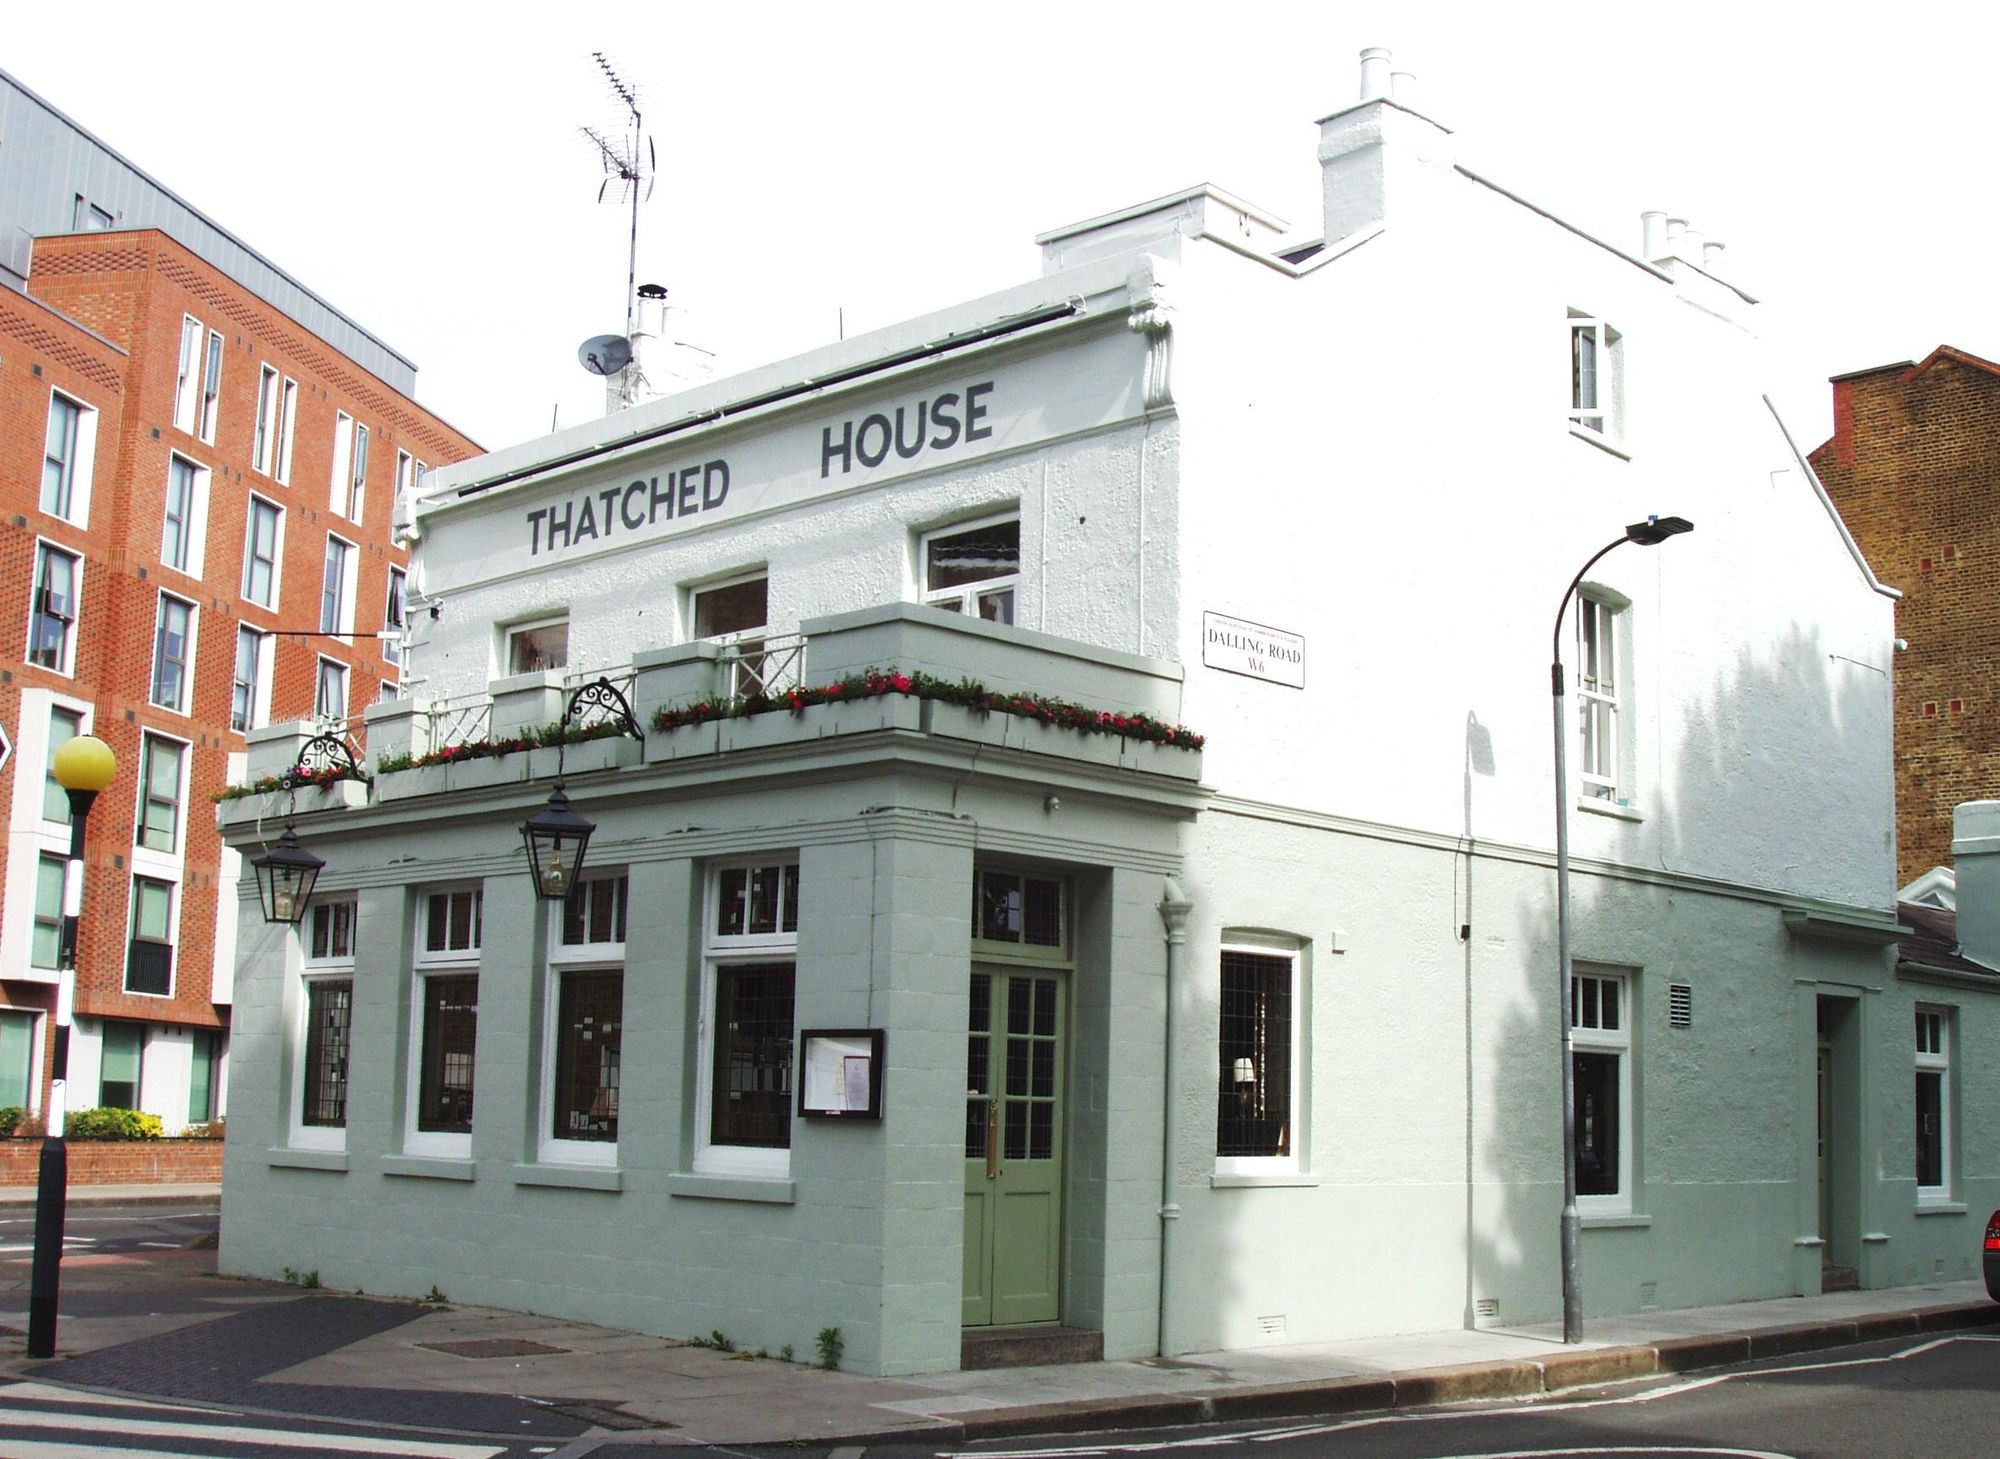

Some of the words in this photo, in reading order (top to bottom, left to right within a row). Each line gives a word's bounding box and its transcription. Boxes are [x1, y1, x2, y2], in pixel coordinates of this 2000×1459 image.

[527, 458, 731, 556] THATCHED
[821, 381, 995, 479] HOUSE
[1209, 628, 1264, 655] DALLING
[1269, 643, 1301, 664] ROAD
[1248, 657, 1265, 673] W6
